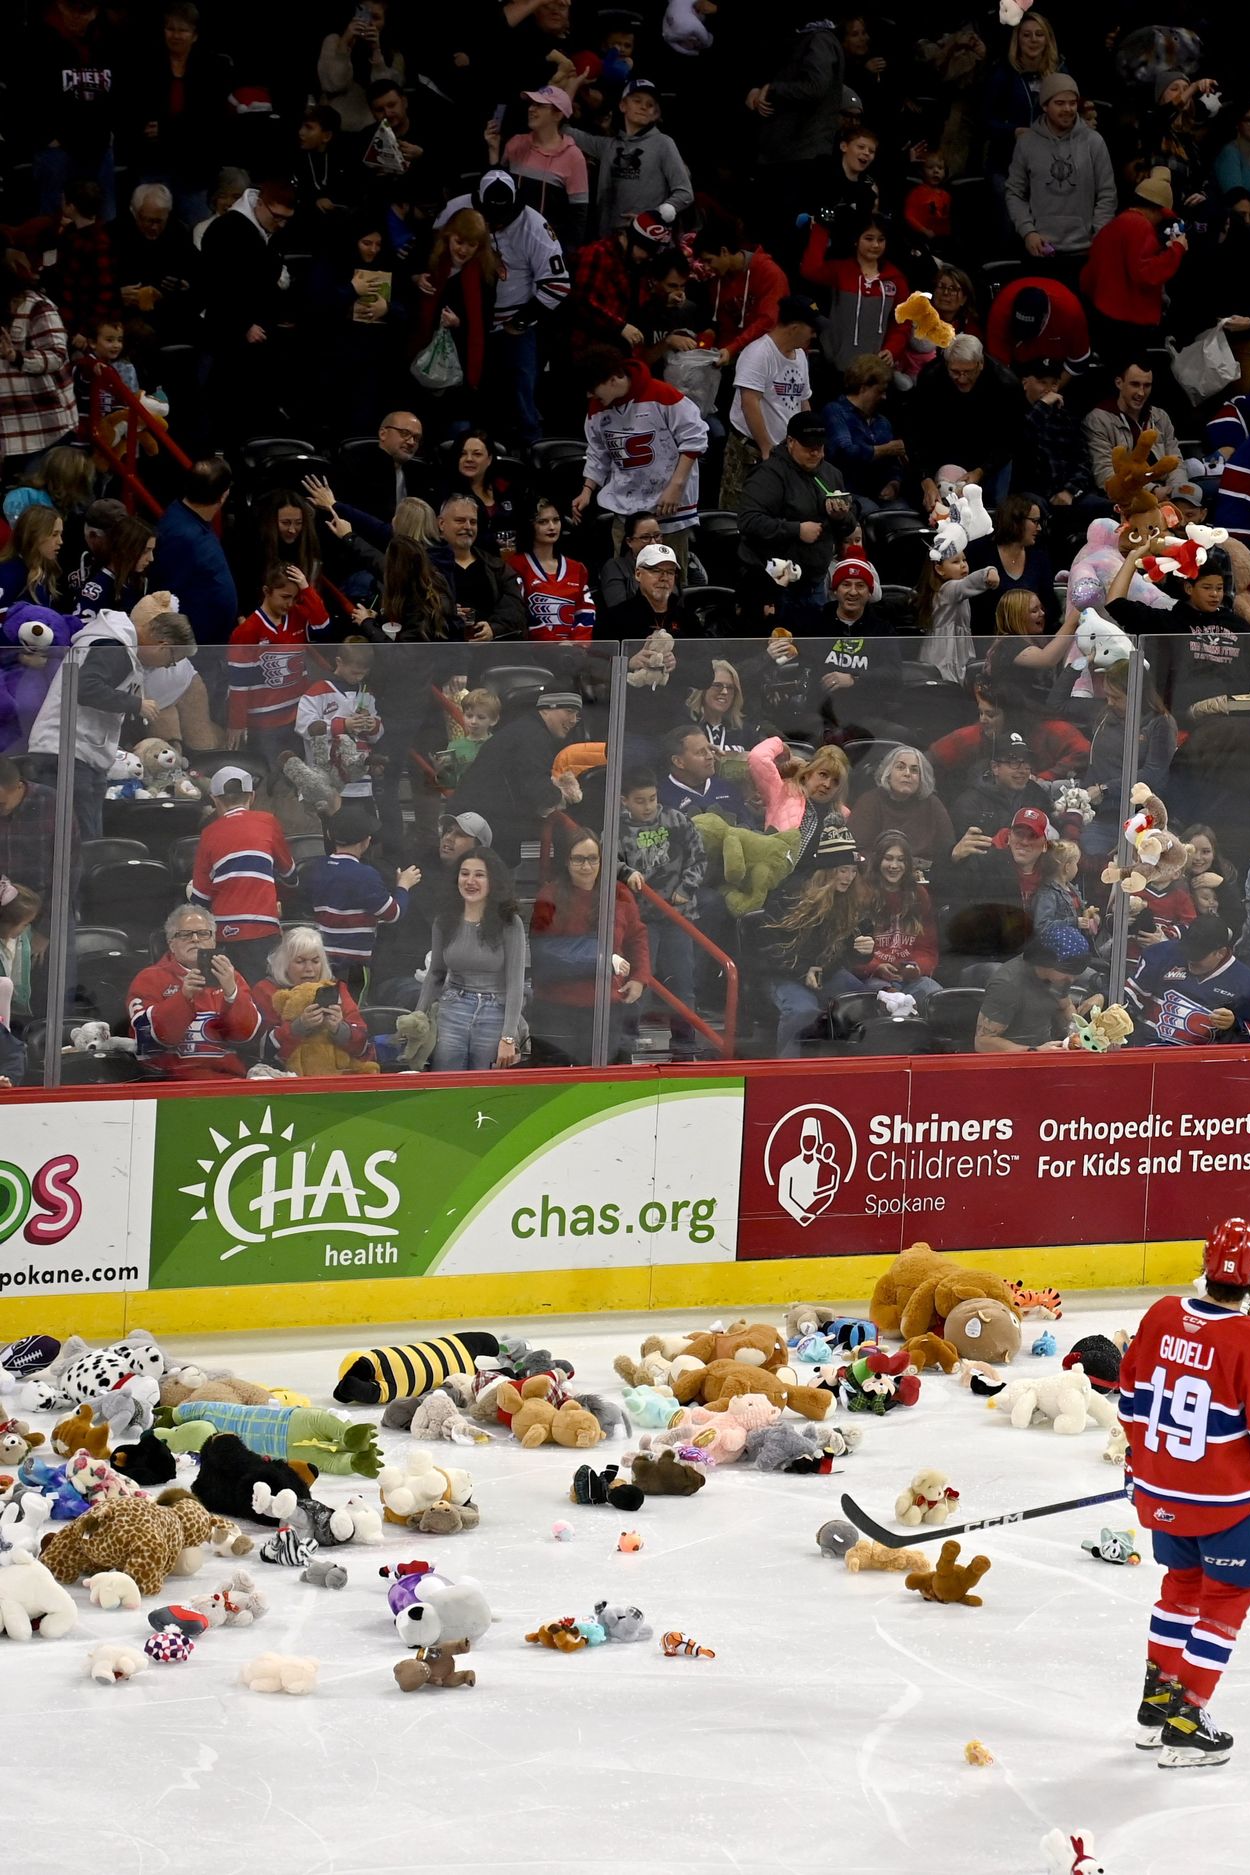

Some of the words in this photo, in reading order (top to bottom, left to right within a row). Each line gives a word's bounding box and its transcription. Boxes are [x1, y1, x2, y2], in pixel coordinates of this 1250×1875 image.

[824, 651, 869, 671] ADM
[868, 1113, 1013, 1145] Shriners
[1039, 1115, 1173, 1144] Orthopedic
[1037, 1156, 1075, 1178] For
[1082, 1152, 1131, 1177] Kids
[1137, 1150, 1182, 1174] and
[213, 1143, 401, 1243] CHAS
[864, 1195, 946, 1218] Spokane
[511, 1194, 718, 1244] chas.org
[324, 1241, 399, 1267] health
[1223, 1260, 1237, 1273] 19
[1182, 1315, 1208, 1327] CCM
[1159, 1334, 1215, 1371] GUDELJ
[1144, 1365, 1213, 1462] 19
[964, 1511, 1024, 1534] CCM
[1204, 1555, 1247, 1567] CCM
